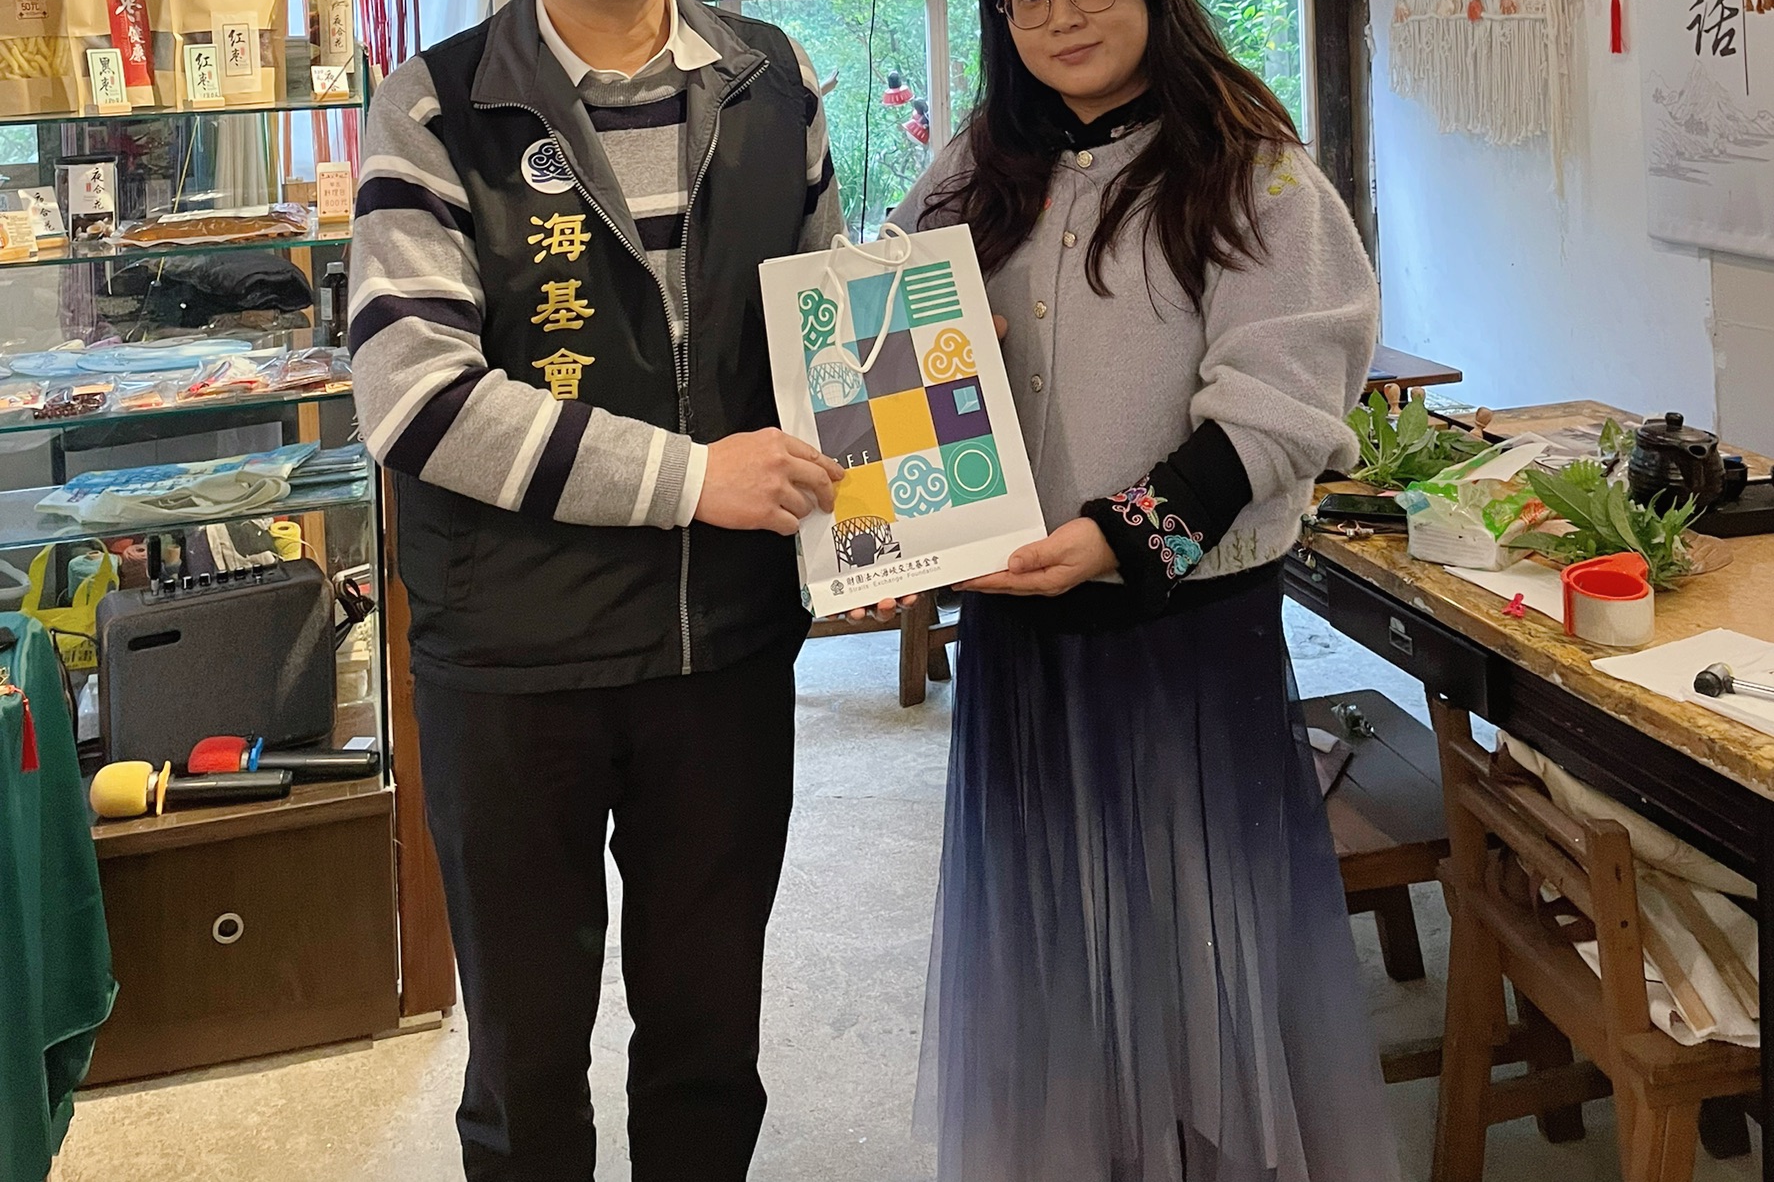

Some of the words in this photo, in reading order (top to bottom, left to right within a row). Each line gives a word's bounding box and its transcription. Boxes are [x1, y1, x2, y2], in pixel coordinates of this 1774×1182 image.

[527, 212, 596, 401] 海基會
[846, 555, 940, 586] 財團法人海峽交流基金會
[873, 575, 904, 587] Exchange
[906, 565, 941, 578] Foundation
